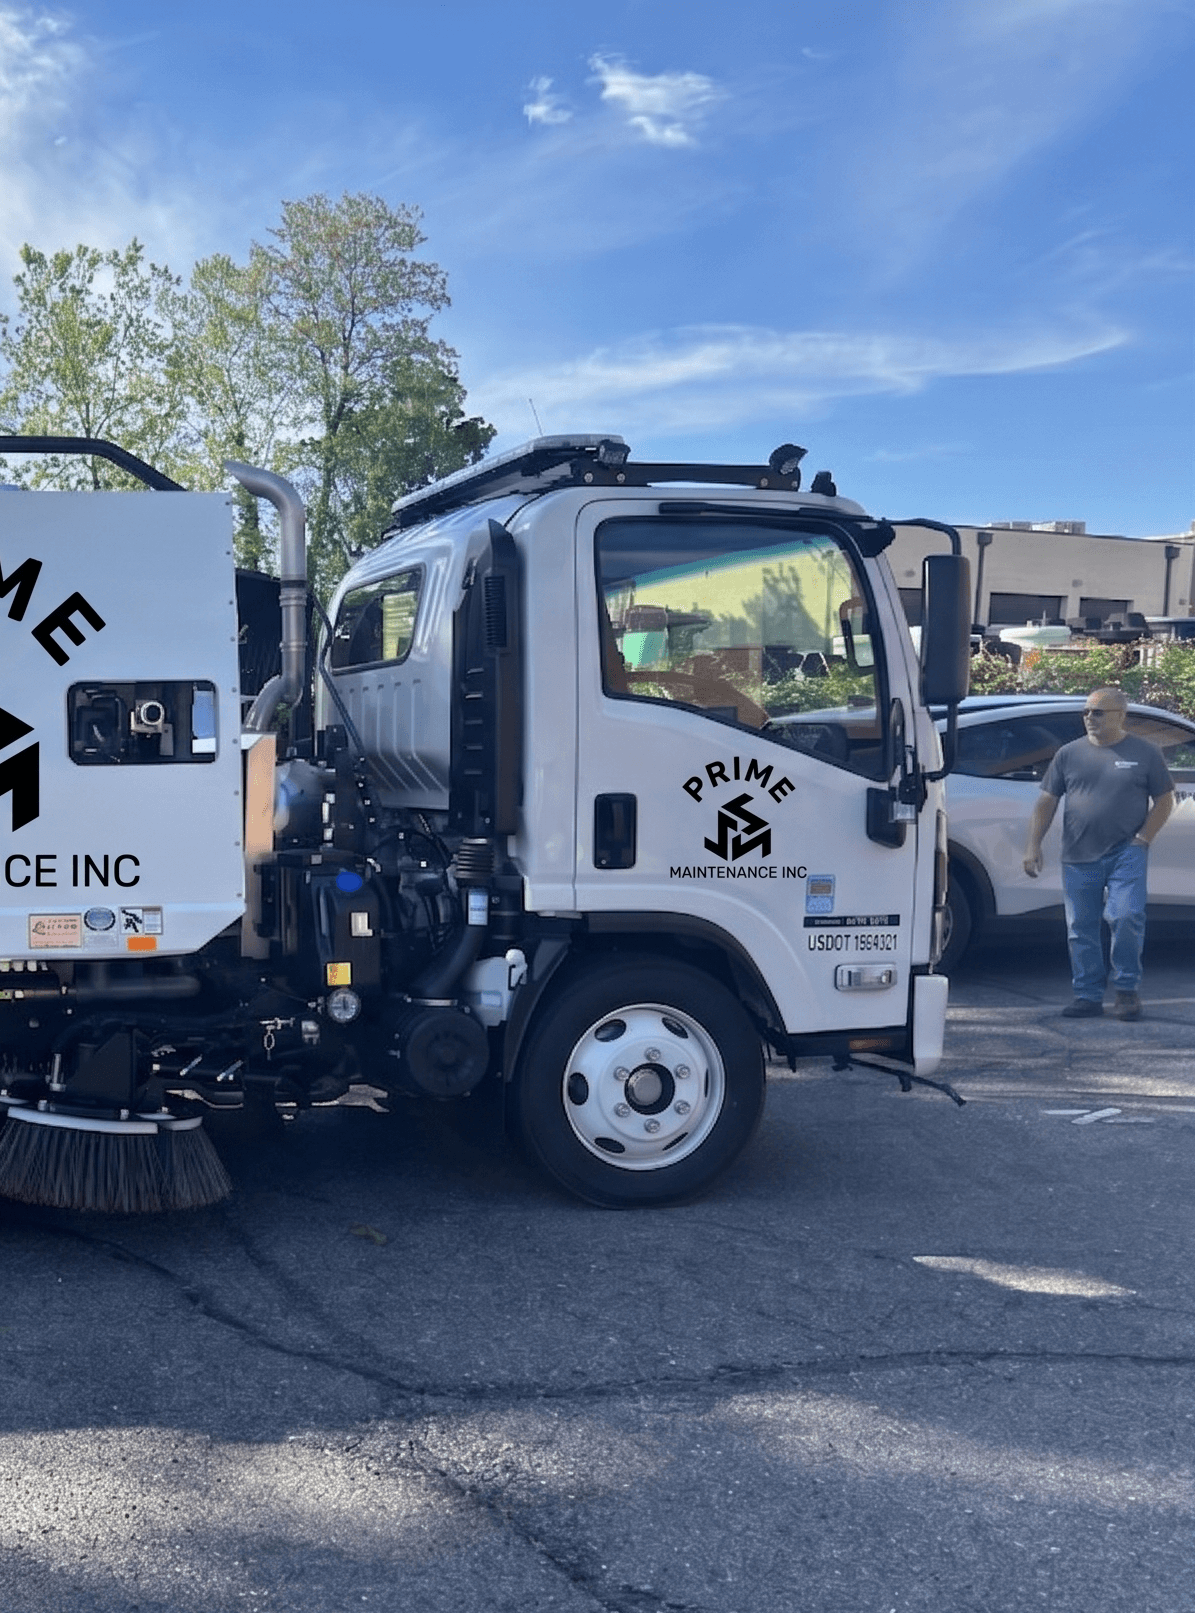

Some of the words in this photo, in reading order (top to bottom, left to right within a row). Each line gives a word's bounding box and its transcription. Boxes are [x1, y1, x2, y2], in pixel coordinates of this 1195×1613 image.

[682, 756, 796, 804] PRIME
[72, 854, 140, 888] INC
[669, 866, 778, 879] MAINTENANCE
[782, 866, 808, 879] INC
[808, 934, 851, 951] USDOT
